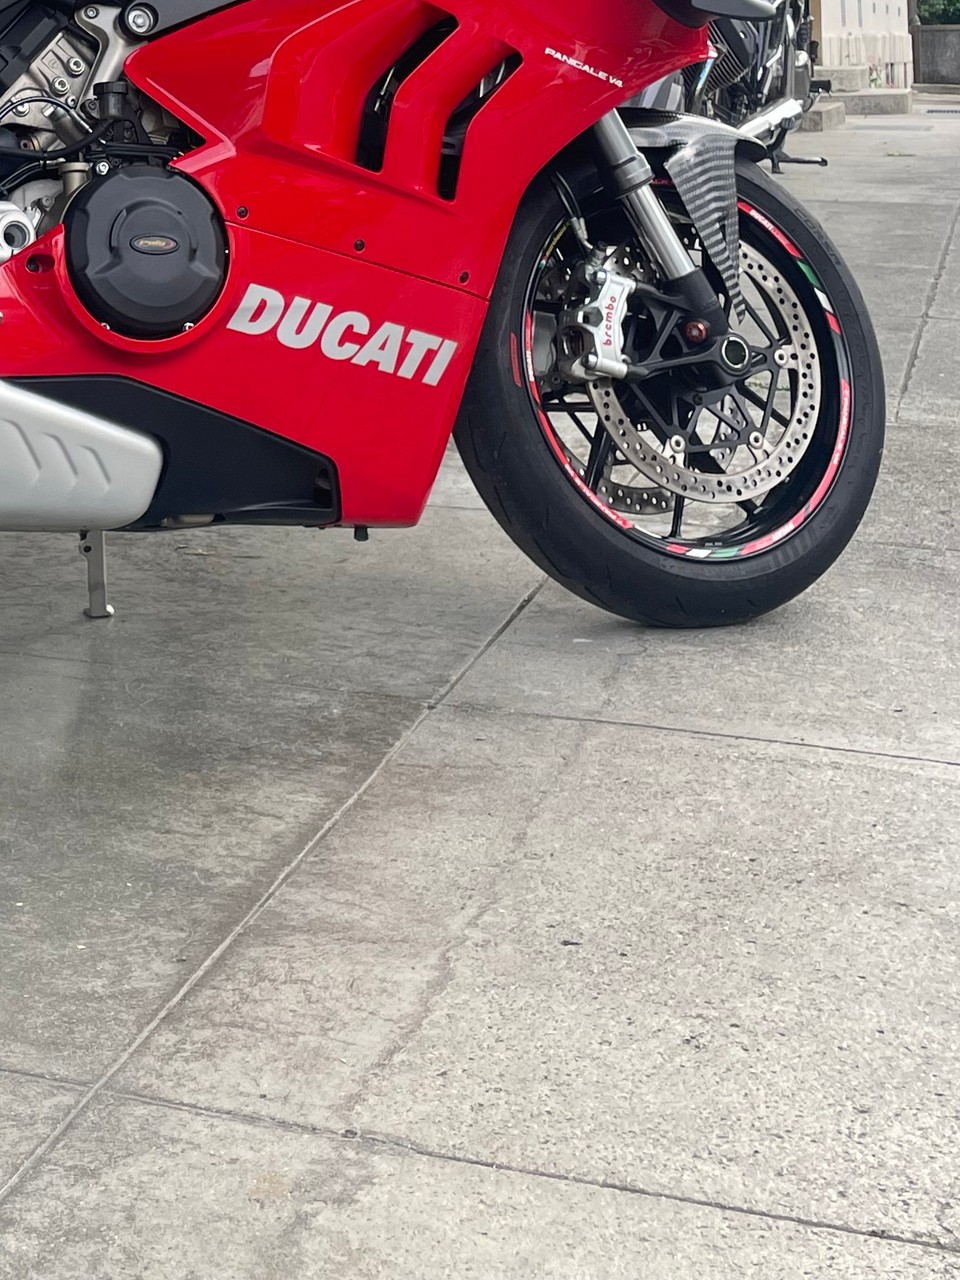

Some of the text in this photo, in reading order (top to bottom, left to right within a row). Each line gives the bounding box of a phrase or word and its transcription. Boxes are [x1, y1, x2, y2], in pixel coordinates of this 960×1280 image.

[544, 47, 624, 88] PANIGALE V4
[226, 283, 458, 387] DUCATI
[602, 296, 617, 347] brembo
